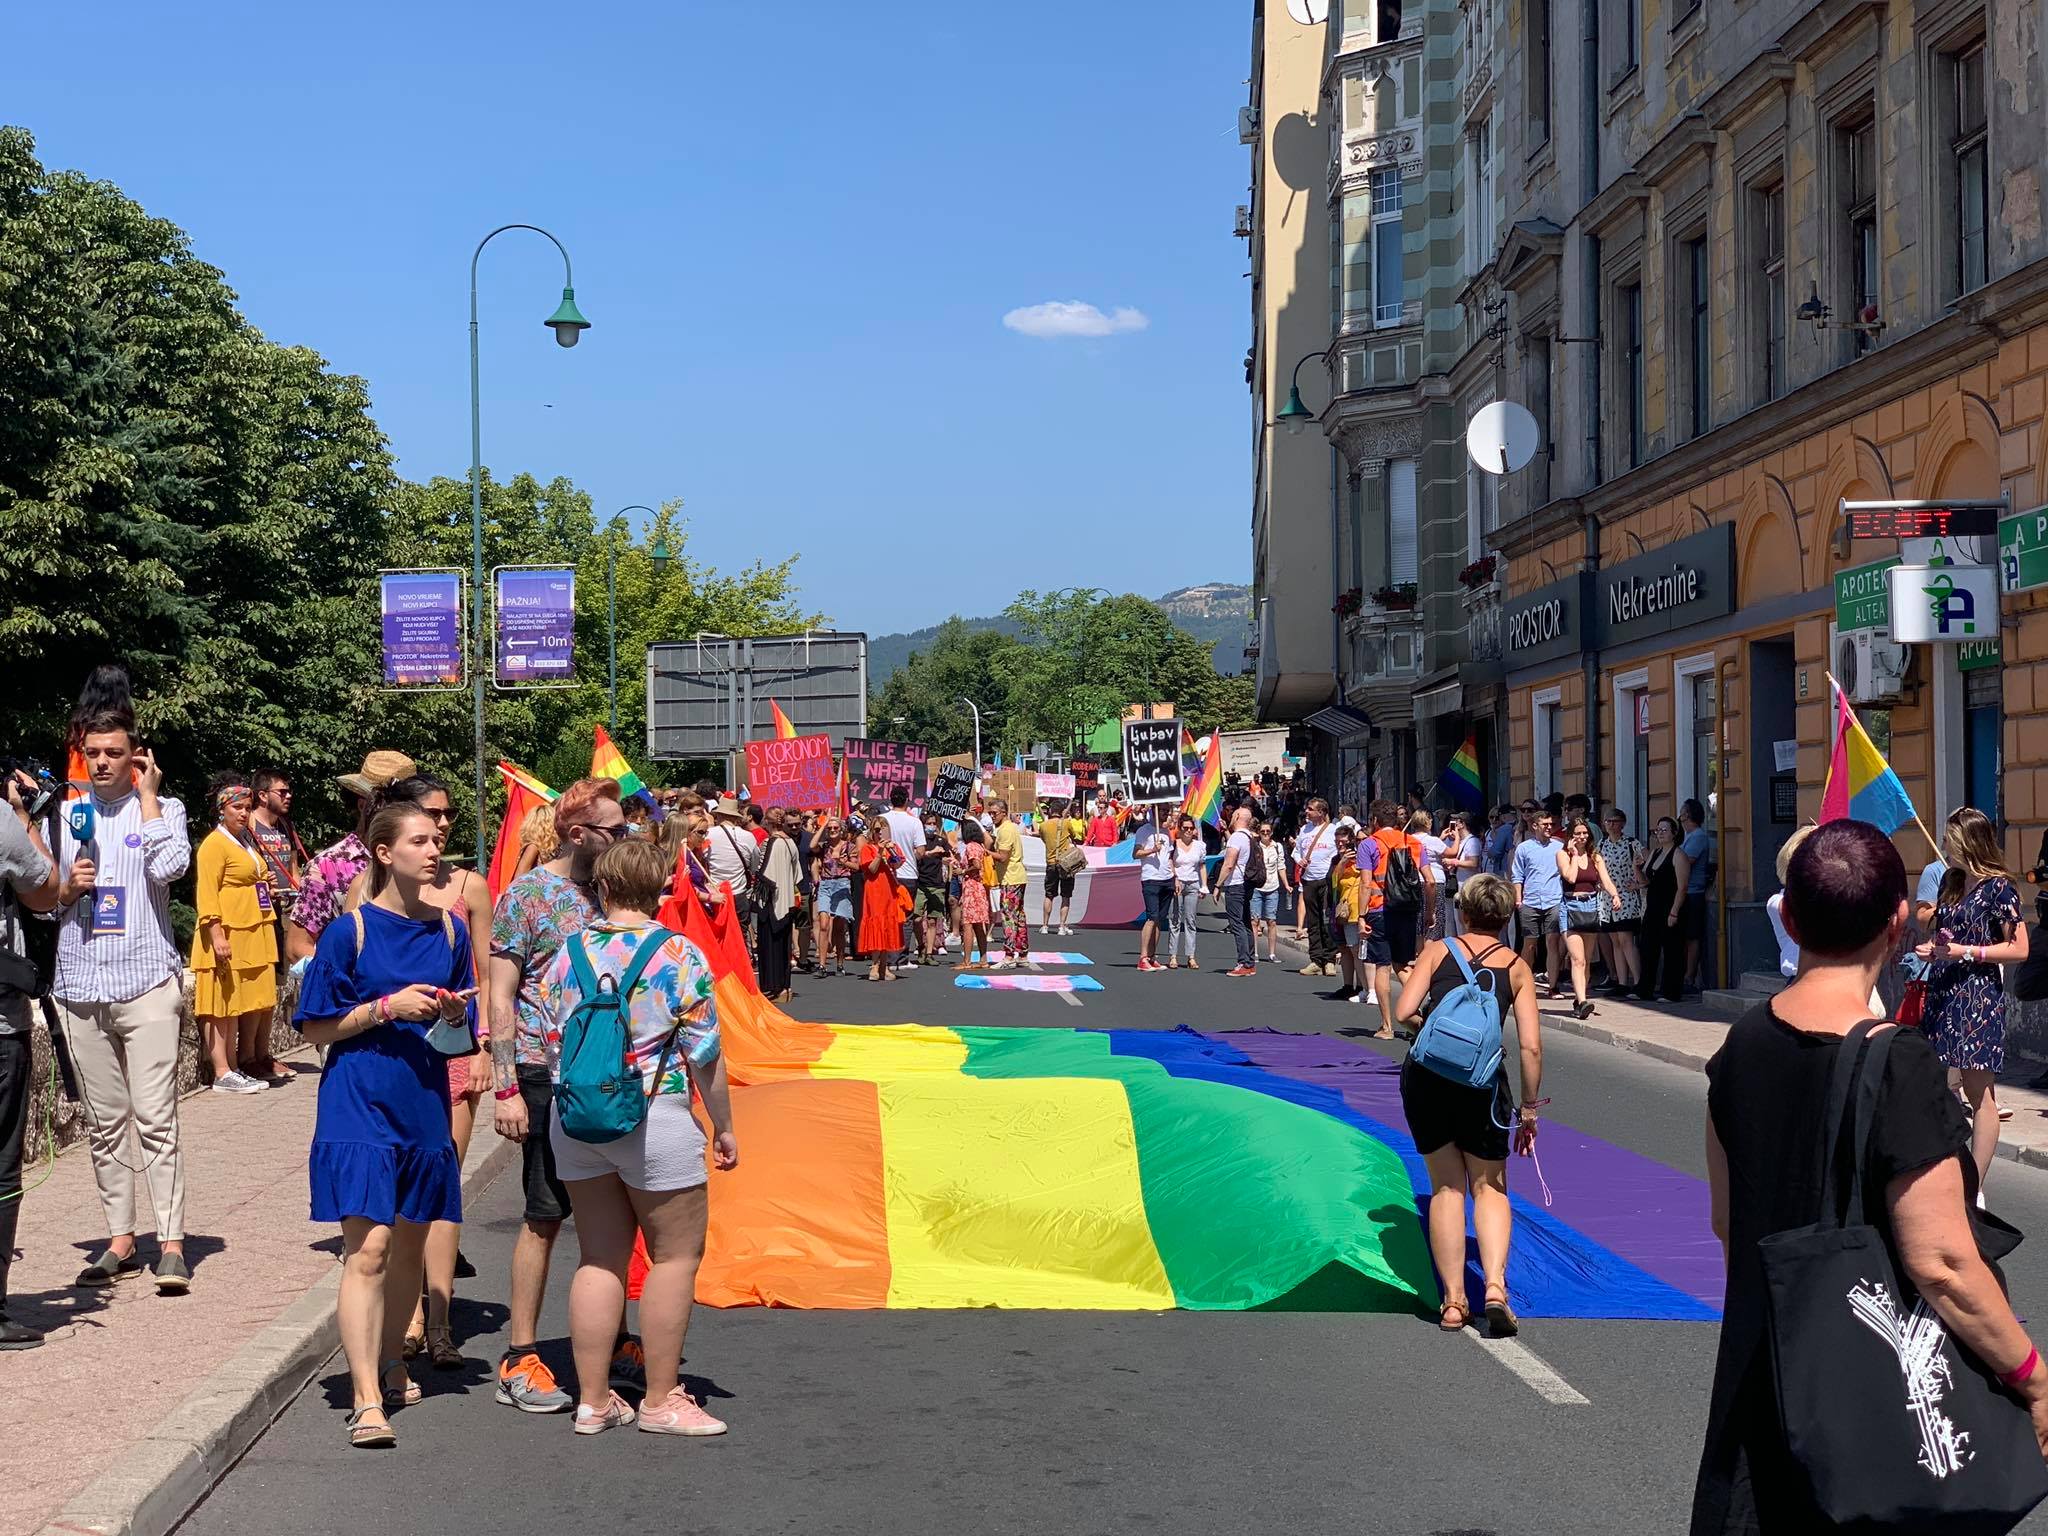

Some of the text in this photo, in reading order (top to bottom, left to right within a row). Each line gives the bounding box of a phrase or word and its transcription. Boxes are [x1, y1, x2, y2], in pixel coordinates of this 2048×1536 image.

[506, 596, 541, 606] PAŽNJA!
[1509, 563, 1696, 651] PROSTOR Nekretnine
[1856, 602, 1886, 623] ALTEA
[541, 636, 568, 647] 10m
[750, 737, 830, 766] S KORONOM
[846, 740, 927, 763] ULICE SU
[752, 766, 766, 786] ILI
[769, 763, 802, 784] BEZ
[865, 760, 916, 781] NAŠA
[768, 781, 804, 796] POSLA
